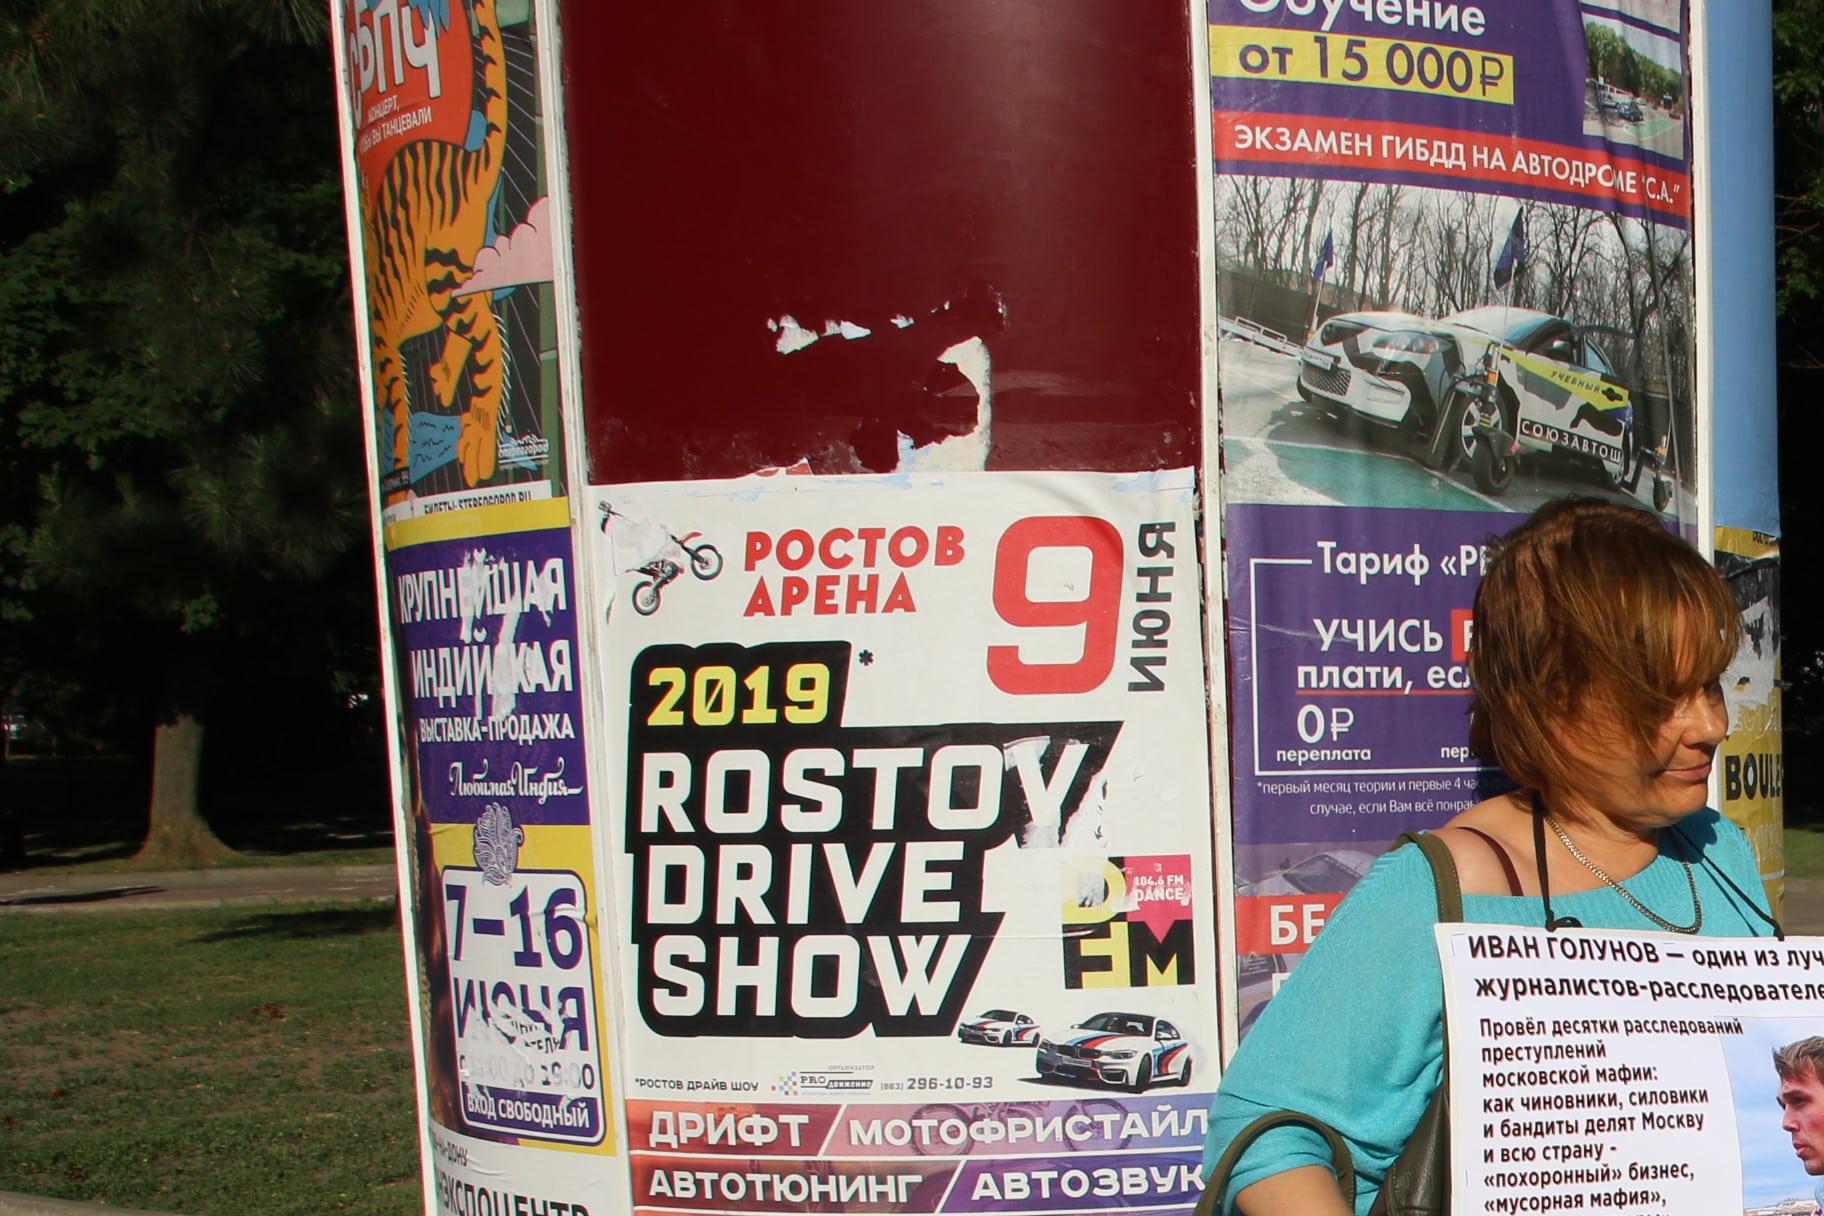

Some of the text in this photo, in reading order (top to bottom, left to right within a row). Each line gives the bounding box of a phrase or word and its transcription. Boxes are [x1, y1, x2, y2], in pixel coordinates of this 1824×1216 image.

[1239, 35, 1369, 82] от 15
[381, 106, 432, 137] ТАНЦЕВАЛИ
[1235, 125, 1372, 157] ЭКЗАМЕН
[1382, 135, 1466, 170] ГИБДД
[1473, 146, 1506, 170] НА
[1512, 150, 1637, 193] АВТОДРОМЕ
[1521, 421, 1621, 463] СОЮЗАВТОШ
[1317, 540, 1430, 585] Тариф
[398, 556, 567, 624] КРУПНЙШАЯ
[743, 572, 916, 617] АРЕНА
[744, 516, 1176, 695] РОСТОВ 9 ИЮНЯ
[1313, 619, 1444, 653] УЧИСЬ
[411, 628, 573, 708] ИНДИЙКАЯ
[1297, 665, 1413, 695] плати,
[419, 712, 575, 745] ВЫСТАВКА-ПРОДАЖА
[1276, 747, 1371, 766] переплата
[450, 757, 583, 804] Любимая Индия
[640, 741, 1089, 833] ROSTOV
[1314, 781, 1351, 794] месяц
[1354, 780, 1396, 794] теории
[1399, 782, 1405, 791] и
[1409, 779, 1451, 793] первые
[1453, 777, 1460, 790] 4
[1310, 798, 1433, 818] случае, если Вам всё
[647, 842, 964, 925] DRIVE
[1134, 875, 1184, 886] 104.6 FM
[1134, 887, 1184, 900] DANCE
[446, 884, 583, 970] 7-16
[1469, 936, 1540, 958] ИВАН
[1547, 937, 1659, 963] ГОЛУНОВ
[1693, 950, 1747, 969] один
[1755, 950, 1779, 966] из
[652, 934, 967, 1017] SHOW
[1480, 1017, 1743, 1040] Провёл десятки расследований
[1482, 1040, 1606, 1065] преступлений
[687, 1078, 728, 1092] ДРАЙВ
[731, 1079, 759, 1092] ШОУ
[907, 1076, 993, 1090] 296-10-93
[1483, 1064, 1657, 1087] московской мафии:
[467, 1094, 590, 1129] ВХОД СВОБОДНЫЙ
[1484, 1090, 1708, 1113] как чиновники, силовики
[649, 1110, 809, 1148] ДРИФТ
[849, 1104, 1207, 1145] МОТОФРИСТАЙЛ
[1484, 1112, 1703, 1138] и бандиты делят Москву
[1484, 1144, 1603, 1163] и всю страну
[649, 1169, 922, 1203] АВТОТЮНИНГ
[972, 1164, 1206, 1201] АВТОЗВУК
[1484, 1162, 1693, 1189] «похоронный» бизнес,
[1485, 1188, 1665, 1215] «мусорная мафия»,
